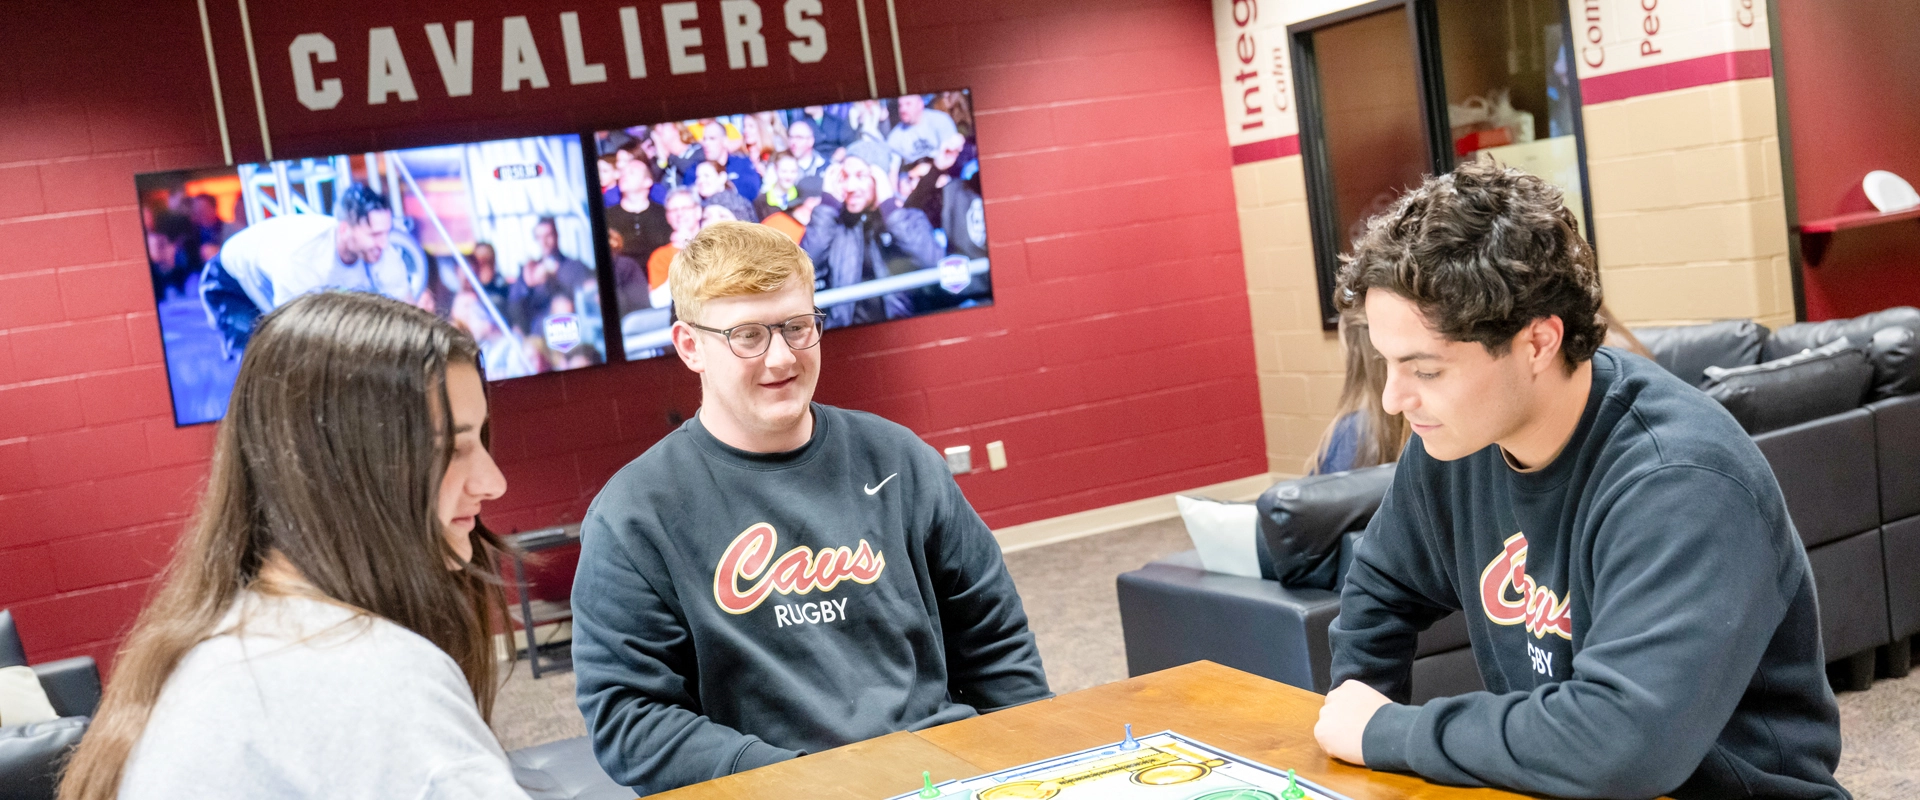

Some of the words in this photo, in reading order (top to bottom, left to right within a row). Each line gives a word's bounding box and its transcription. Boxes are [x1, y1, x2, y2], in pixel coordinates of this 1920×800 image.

[289, 0, 828, 110] CAVALIERS
[1273, 48, 1287, 112] Calm
[714, 522, 886, 615] Cavs
[774, 597, 848, 628] RUGBY
